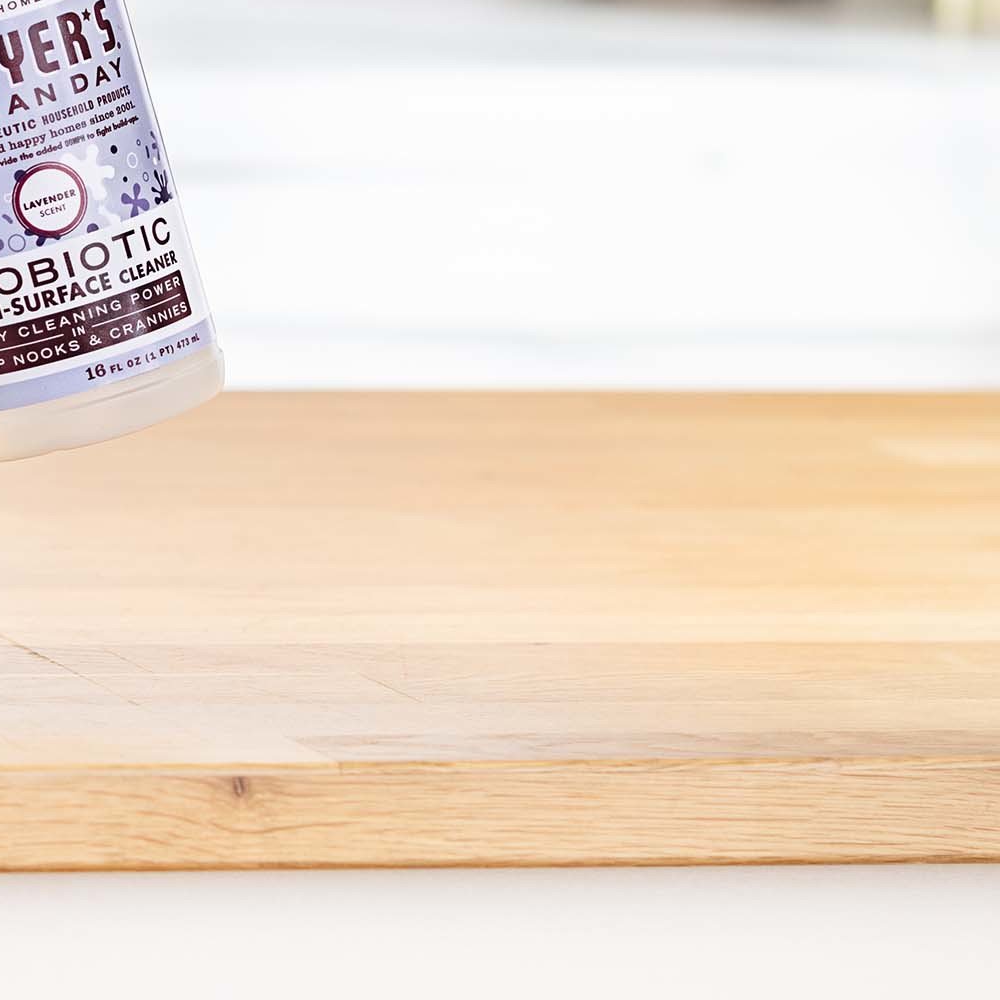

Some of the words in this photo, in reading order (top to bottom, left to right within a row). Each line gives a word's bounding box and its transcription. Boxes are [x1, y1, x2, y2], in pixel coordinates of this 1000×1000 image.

[70, 57, 121, 95] DAY
[41, 99, 95, 126] HOUSEHOLD
[96, 84, 131, 107] PRODUCTS
[8, 132, 46, 151] happy
[49, 121, 87, 139] homes
[89, 110, 115, 126] since
[19, 151, 34, 162] the
[35, 140, 63, 156] added
[86, 132, 95, 141] to
[96, 125, 112, 138] fight
[23, 188, 77, 211] LAVENDER
[39, 204, 67, 218] SCENT
[119, 250, 178, 284] CLEANER
[18, 299, 122, 338] CLEANING
[130, 275, 181, 305] POWER
[13, 339, 81, 366] NOOKS
[89, 334, 103, 346] &
[109, 301, 188, 340] CRANNIES
[71, 324, 86, 338] IN
[85, 363, 107, 380] 16
[109, 363, 124, 374] FL
[127, 356, 142, 368] OZ
[145, 351, 157, 363] (1
[159, 344, 175, 358] PT)
[176, 337, 190, 350] 473
[190, 332, 200, 344] mL
